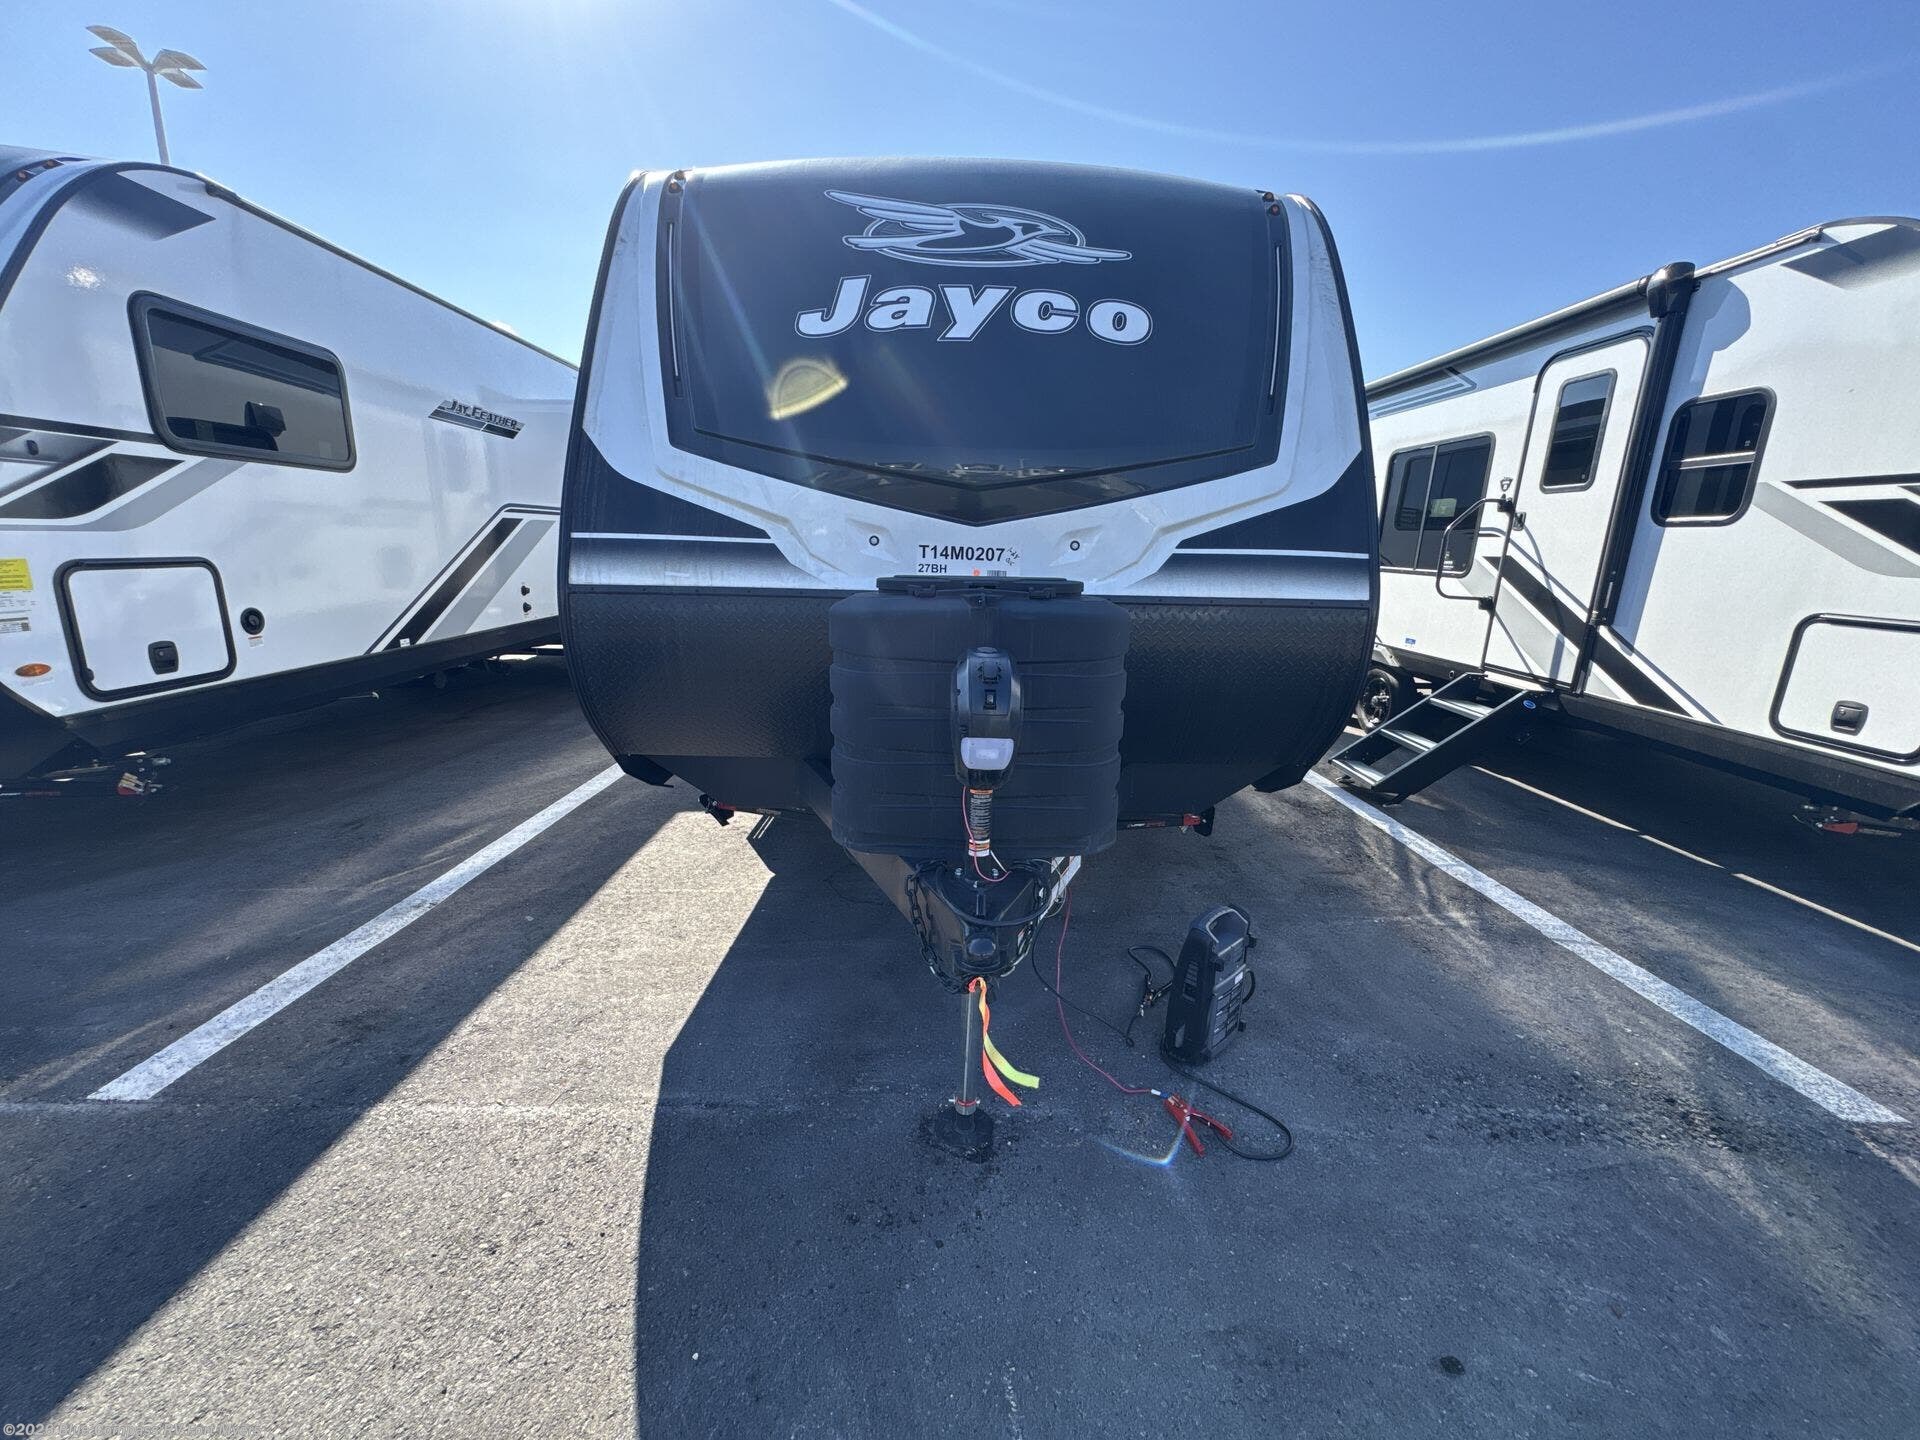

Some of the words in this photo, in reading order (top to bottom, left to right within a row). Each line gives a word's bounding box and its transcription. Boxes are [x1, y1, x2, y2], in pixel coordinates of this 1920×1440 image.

[795, 275, 1152, 345] Jayco
[919, 544, 1005, 562] T14M0207
[918, 563, 947, 573] 27BH
